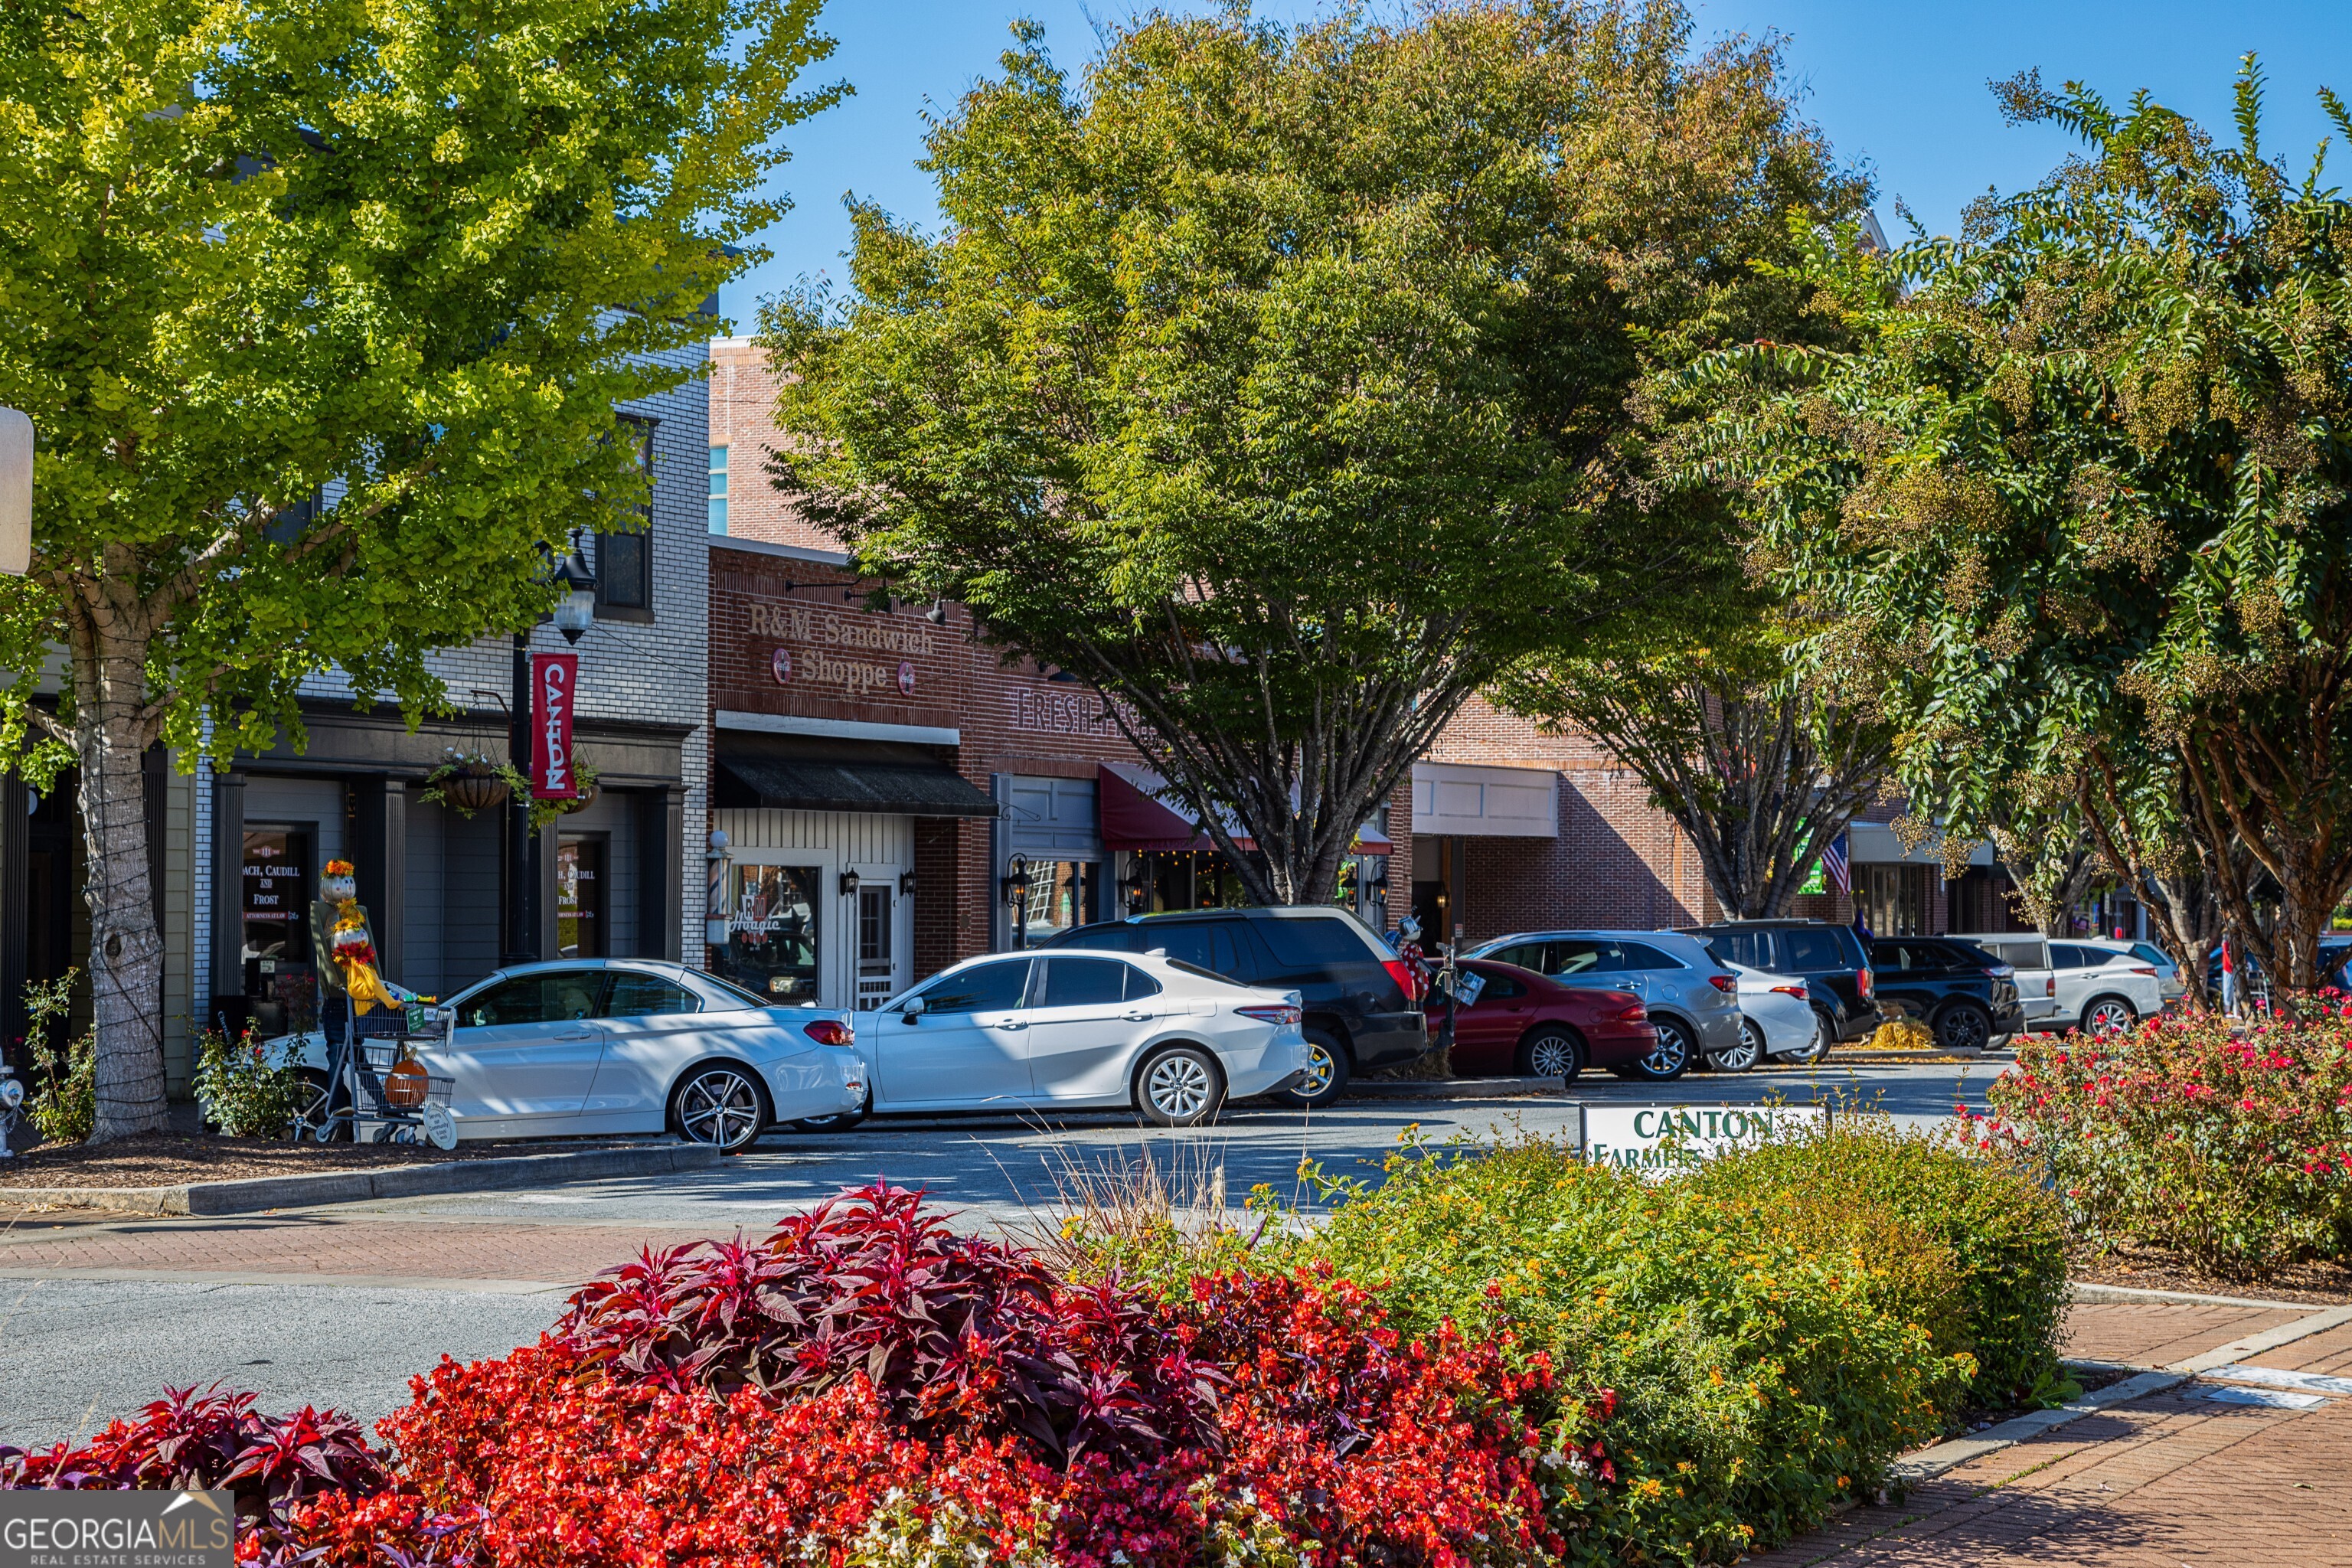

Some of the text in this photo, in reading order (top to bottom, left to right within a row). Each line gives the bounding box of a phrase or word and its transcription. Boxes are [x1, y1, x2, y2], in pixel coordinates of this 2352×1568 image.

[749, 603, 933, 654] R&M Sandwich
[802, 649, 887, 694] Shoppe
[1018, 688, 1091, 734] FRESH
[544, 663, 566, 789] CANTON
[243, 865, 299, 877] ACH, CAUDILL
[260, 879, 272, 888] AND
[253, 894, 279, 904] FROST
[730, 910, 780, 936] Hoagie
[429, 1122, 449, 1132] Community
[1634, 1110, 1773, 1138] CANTON
